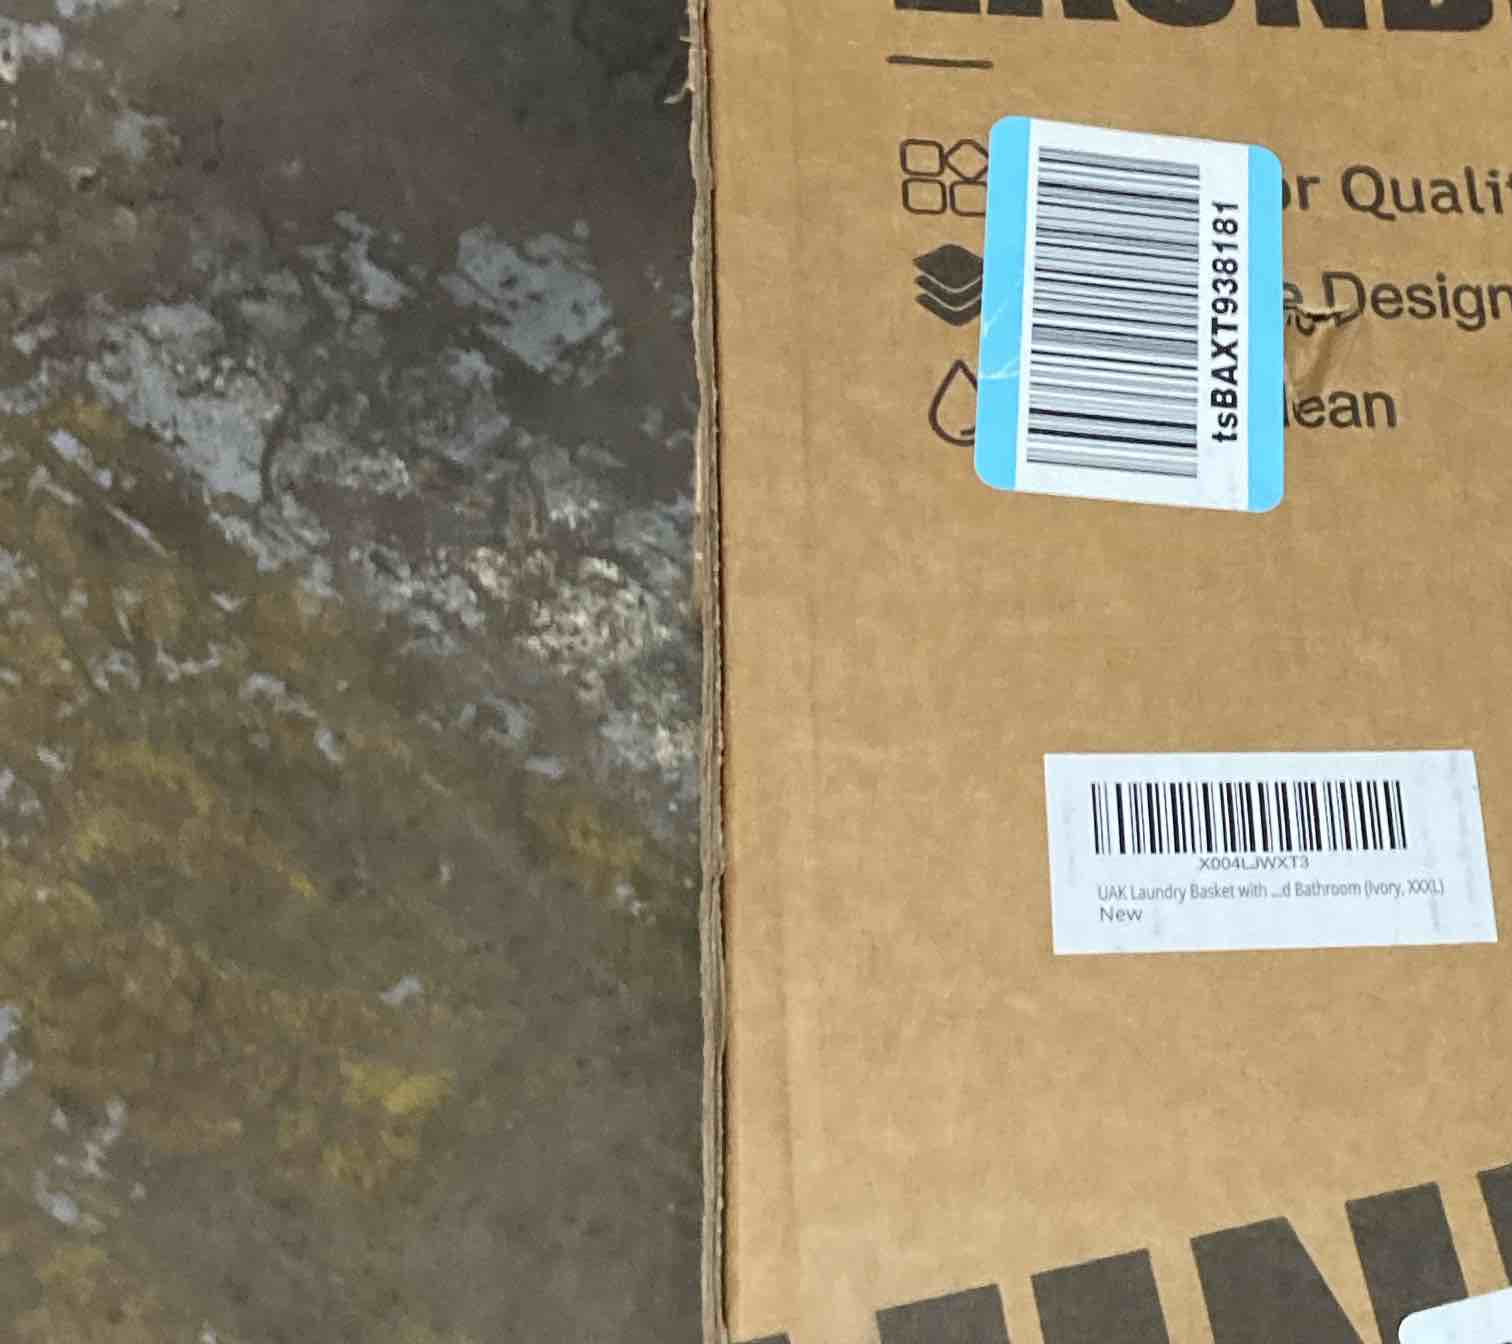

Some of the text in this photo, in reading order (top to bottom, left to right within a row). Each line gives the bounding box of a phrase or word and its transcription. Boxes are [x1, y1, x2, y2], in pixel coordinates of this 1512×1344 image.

[1210, 199, 1240, 444] tsBAXT938181
[1199, 854, 1311, 872] X004LJWXT3
[1130, 883, 1187, 904] Laundry
[1190, 882, 1235, 899] Basket
[1238, 882, 1268, 898] with
[1295, 880, 1362, 897] Bathroom
[1100, 906, 1143, 923] New
